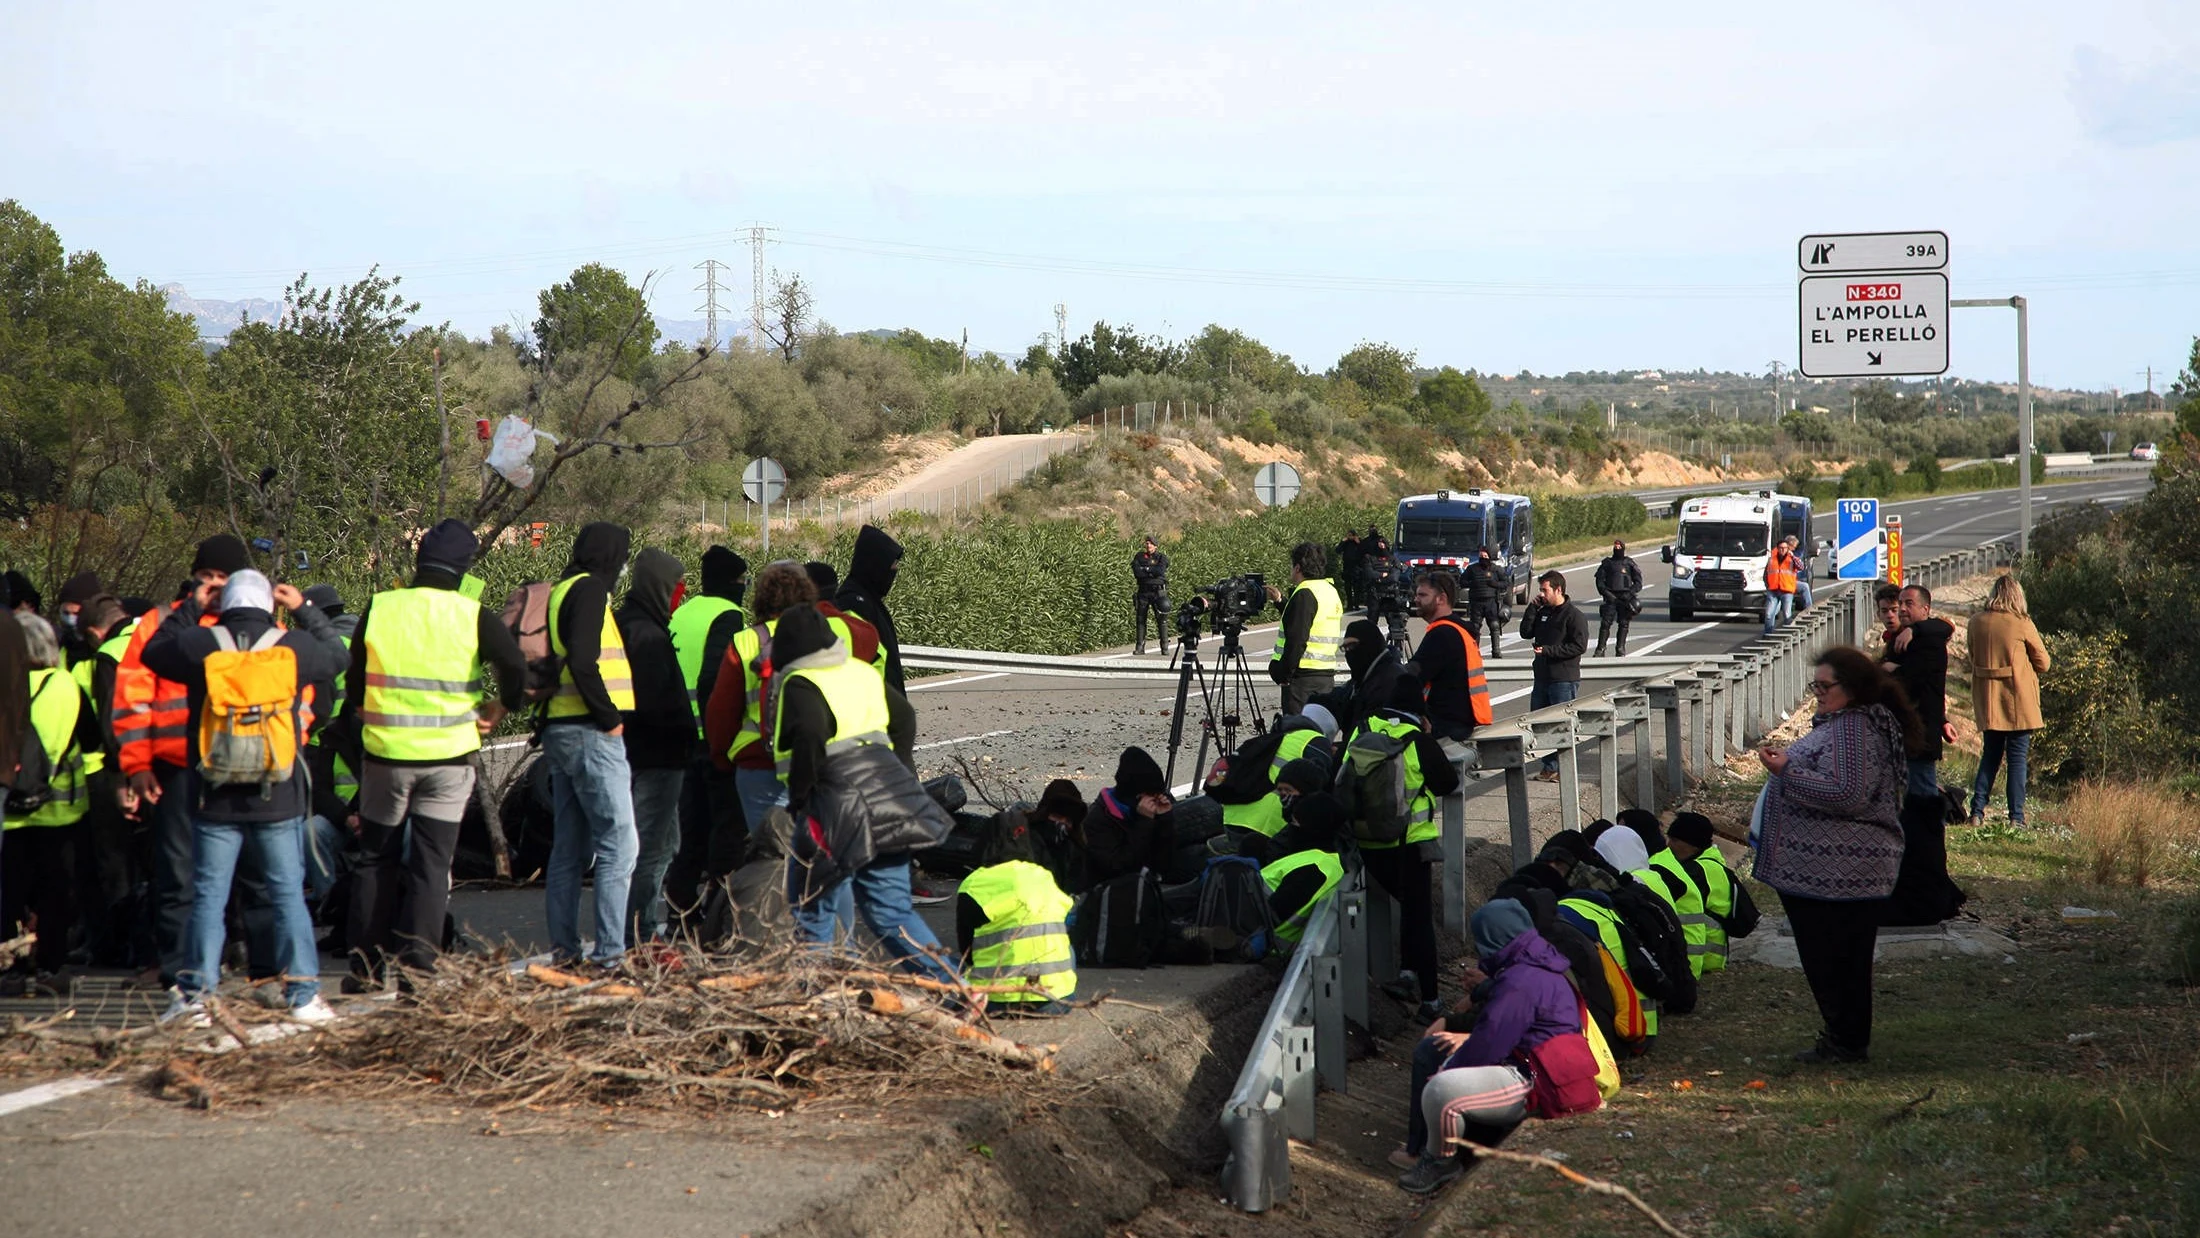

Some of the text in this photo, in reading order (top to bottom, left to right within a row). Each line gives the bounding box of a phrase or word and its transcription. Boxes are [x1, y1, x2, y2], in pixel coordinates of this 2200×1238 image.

[1906, 245, 1937, 257] 39A
[1848, 286, 1899, 299] N-340
[1816, 304, 1927, 321] L'AMPOLLA
[1811, 323, 1936, 343] EL PERELLÓ
[1843, 501, 1871, 514] 100
[1851, 513, 1863, 522] m
